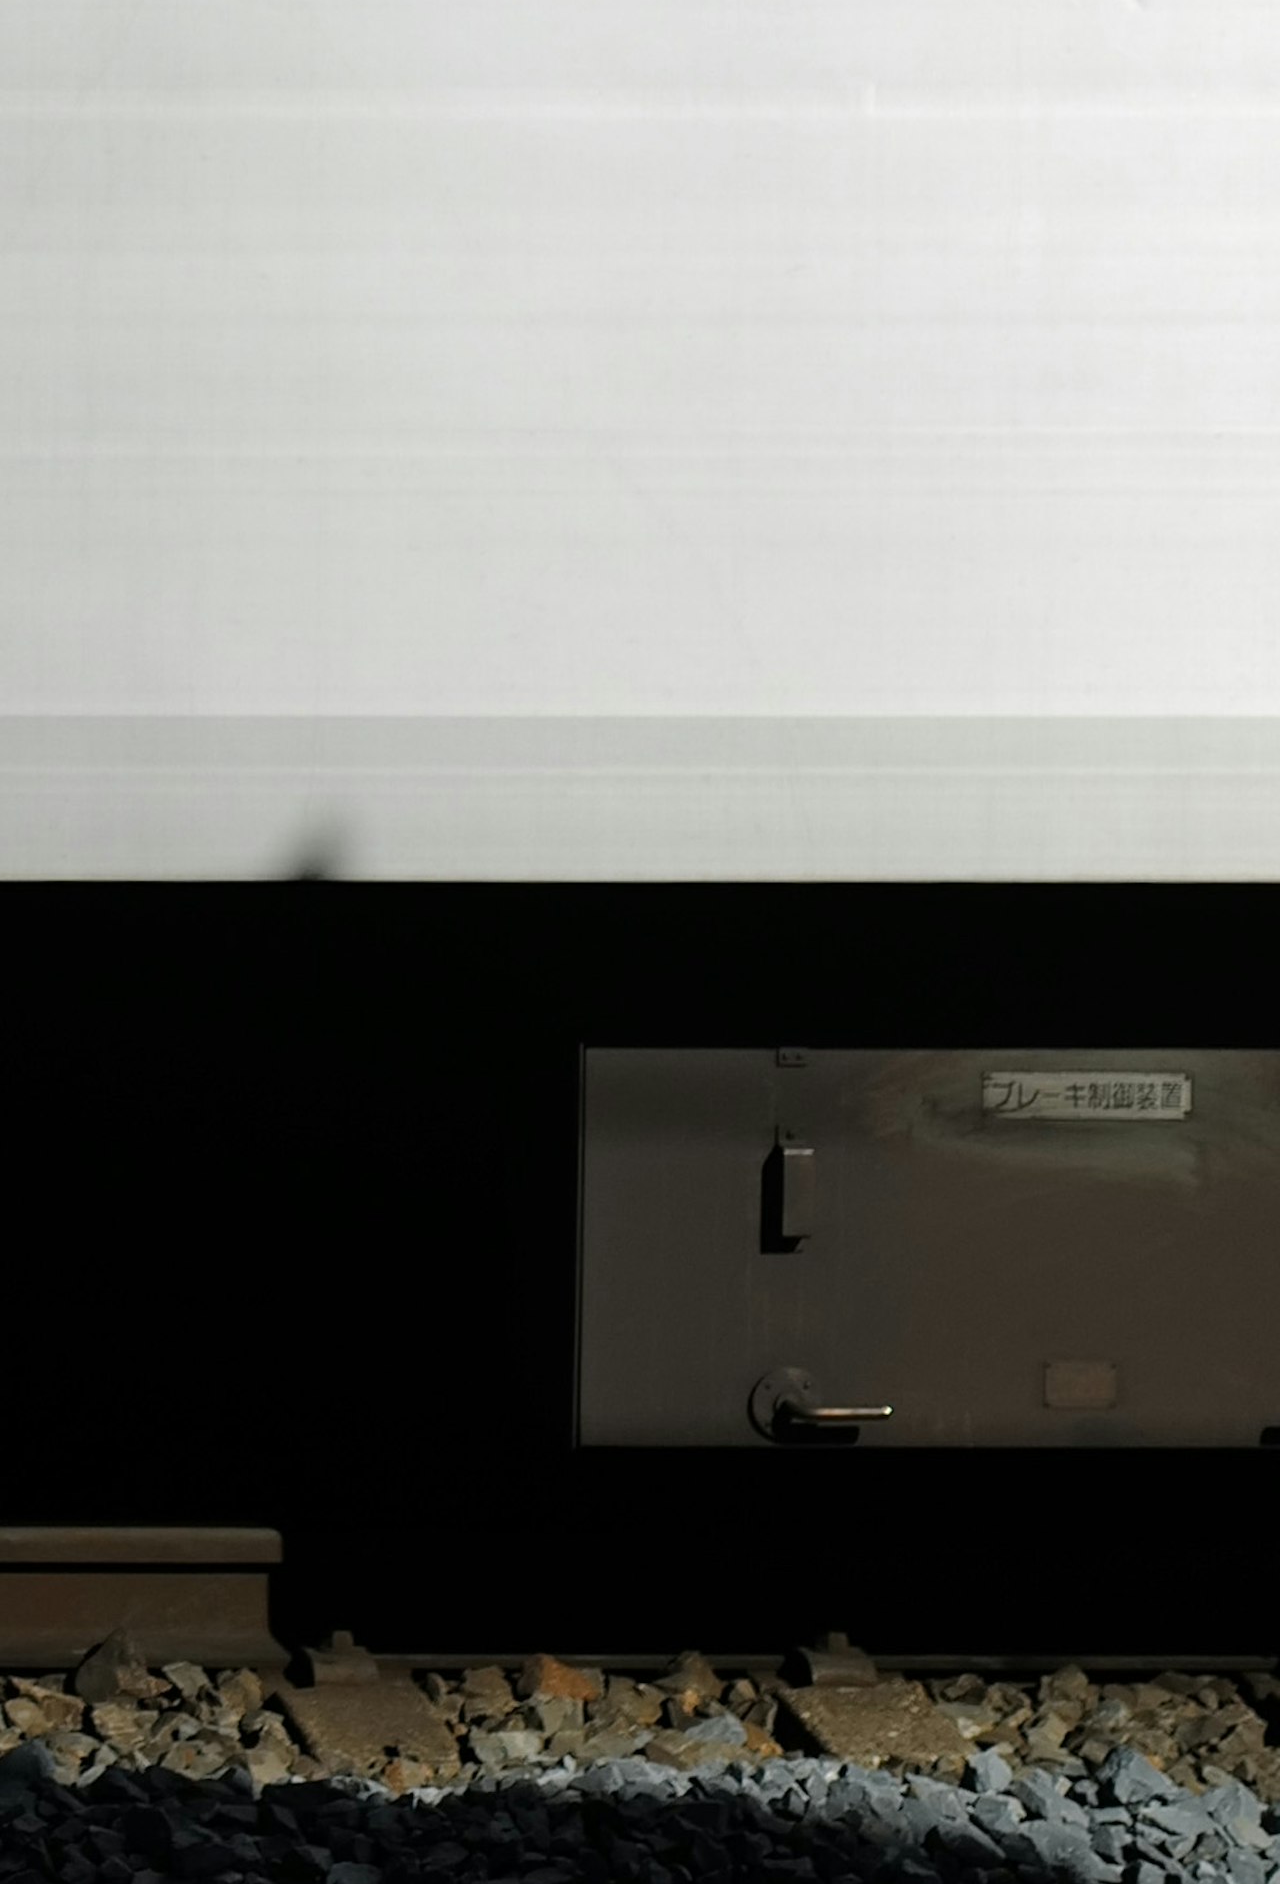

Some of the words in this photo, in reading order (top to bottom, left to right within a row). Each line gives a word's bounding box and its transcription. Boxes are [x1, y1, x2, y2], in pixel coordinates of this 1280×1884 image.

[983, 1080, 1183, 1111] ブレーキ制御装置
